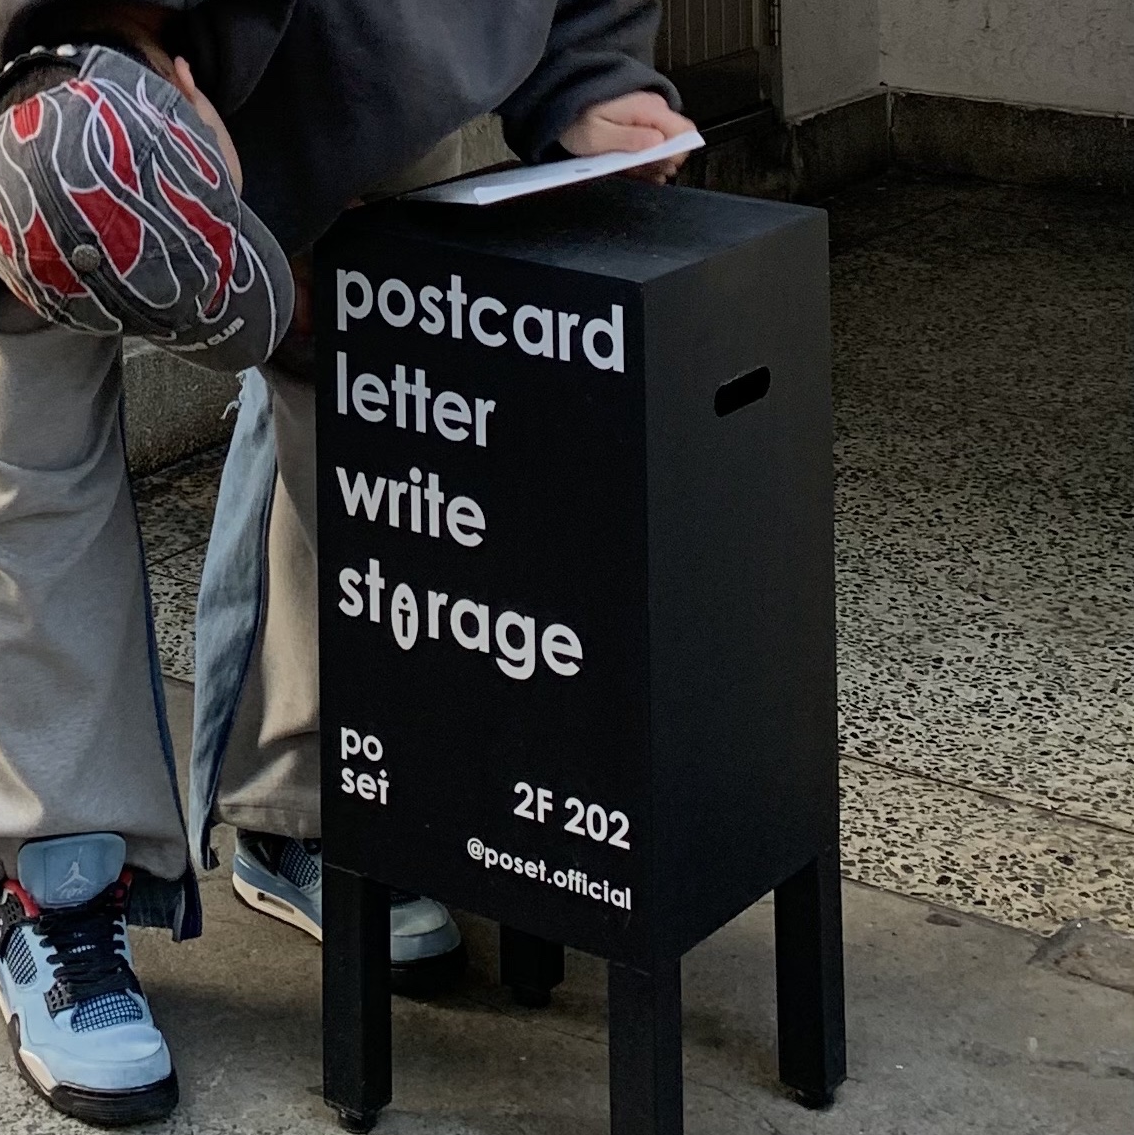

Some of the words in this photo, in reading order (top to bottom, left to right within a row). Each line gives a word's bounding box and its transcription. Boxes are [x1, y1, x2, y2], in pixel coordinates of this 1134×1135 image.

[336, 268, 625, 374] postcard
[336, 350, 497, 448] letter
[335, 466, 486, 548] write
[338, 557, 583, 681] storage
[340, 726, 384, 762] po
[513, 781, 553, 824] 2F
[563, 796, 631, 851] 202
[466, 837, 632, 911] @poset.official
